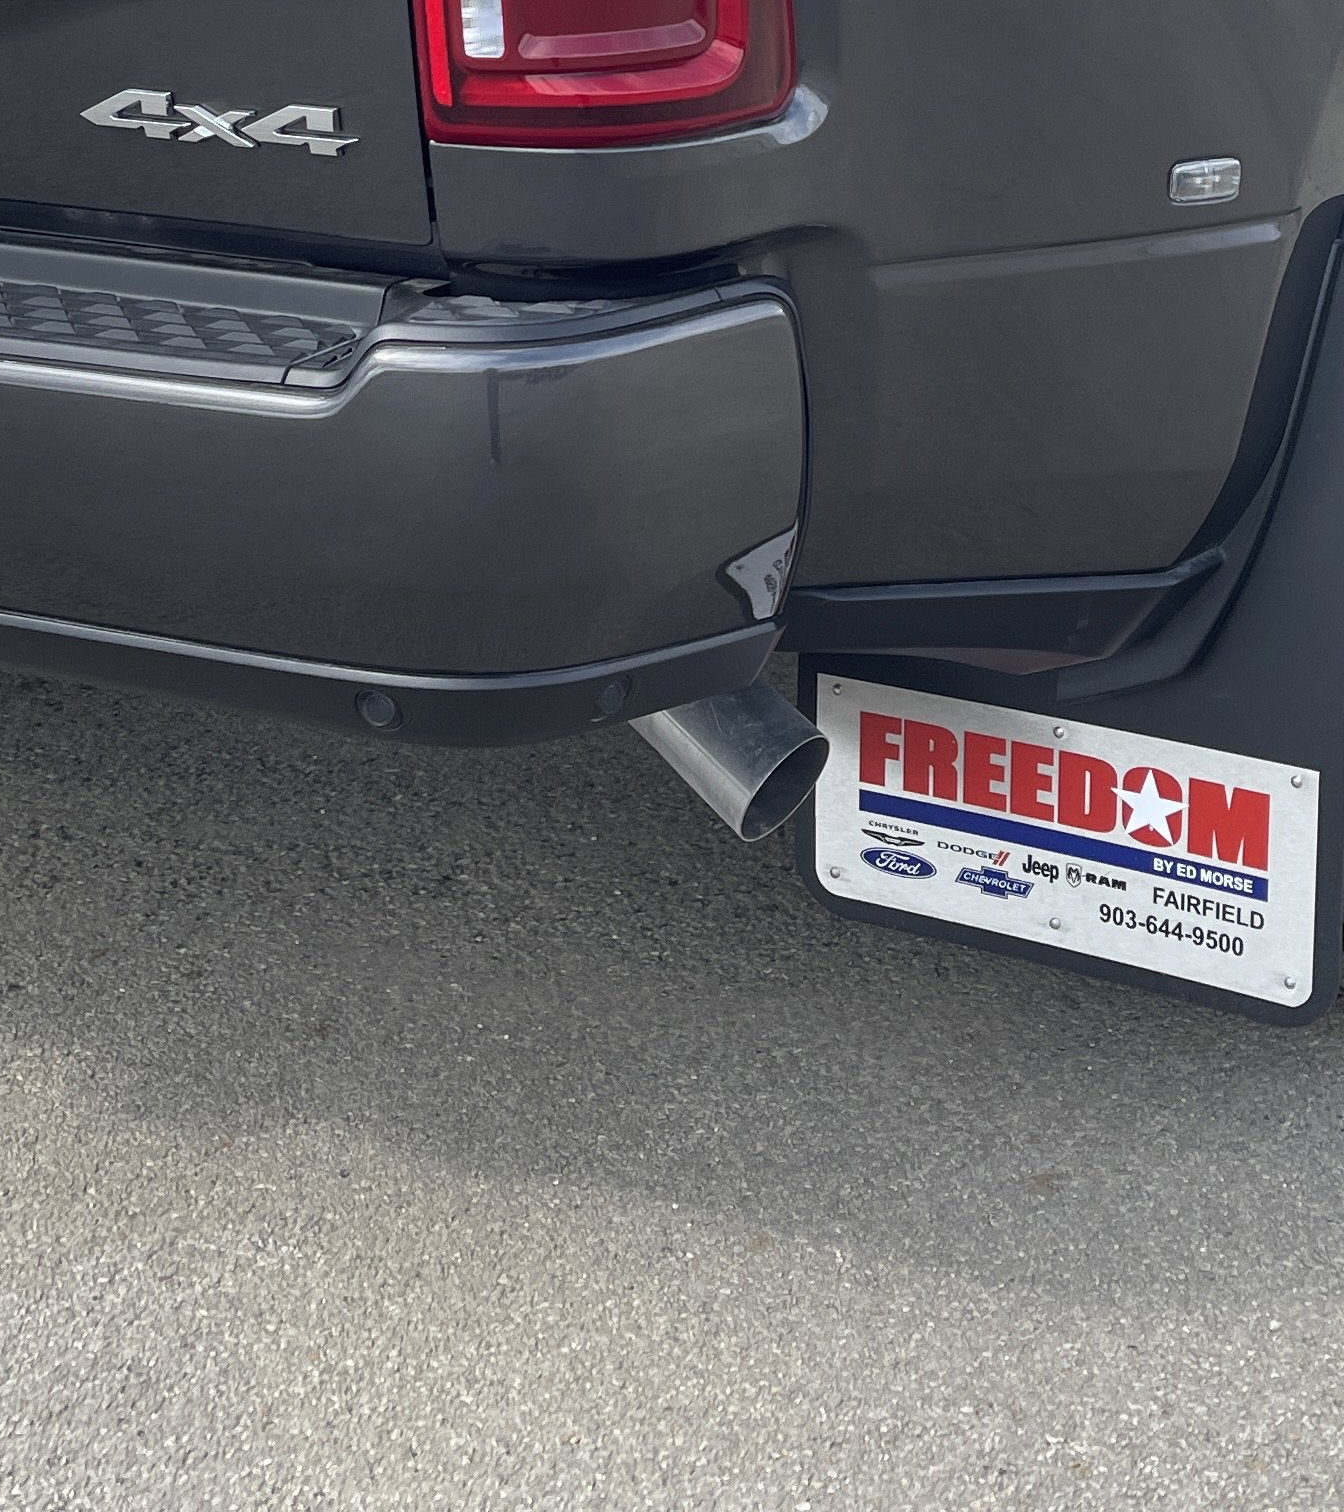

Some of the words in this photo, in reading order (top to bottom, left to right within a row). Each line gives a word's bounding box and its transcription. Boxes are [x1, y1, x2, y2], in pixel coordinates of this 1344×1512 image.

[859, 711, 1269, 871] FREEDOM
[868, 820, 919, 836] CHRYSLER
[875, 851, 922, 876] Ford
[937, 841, 998, 861] DODGE
[963, 872, 1026, 893] CHEVROLET
[1022, 854, 1060, 884] Jeep
[1085, 872, 1127, 892] RAM
[1153, 857, 1173, 874] BY
[1176, 864, 1197, 879] ED
[1200, 868, 1254, 894] MORSE
[1152, 886, 1265, 930] FAIRFIELD
[1099, 903, 1244, 957] 903-644-9500
